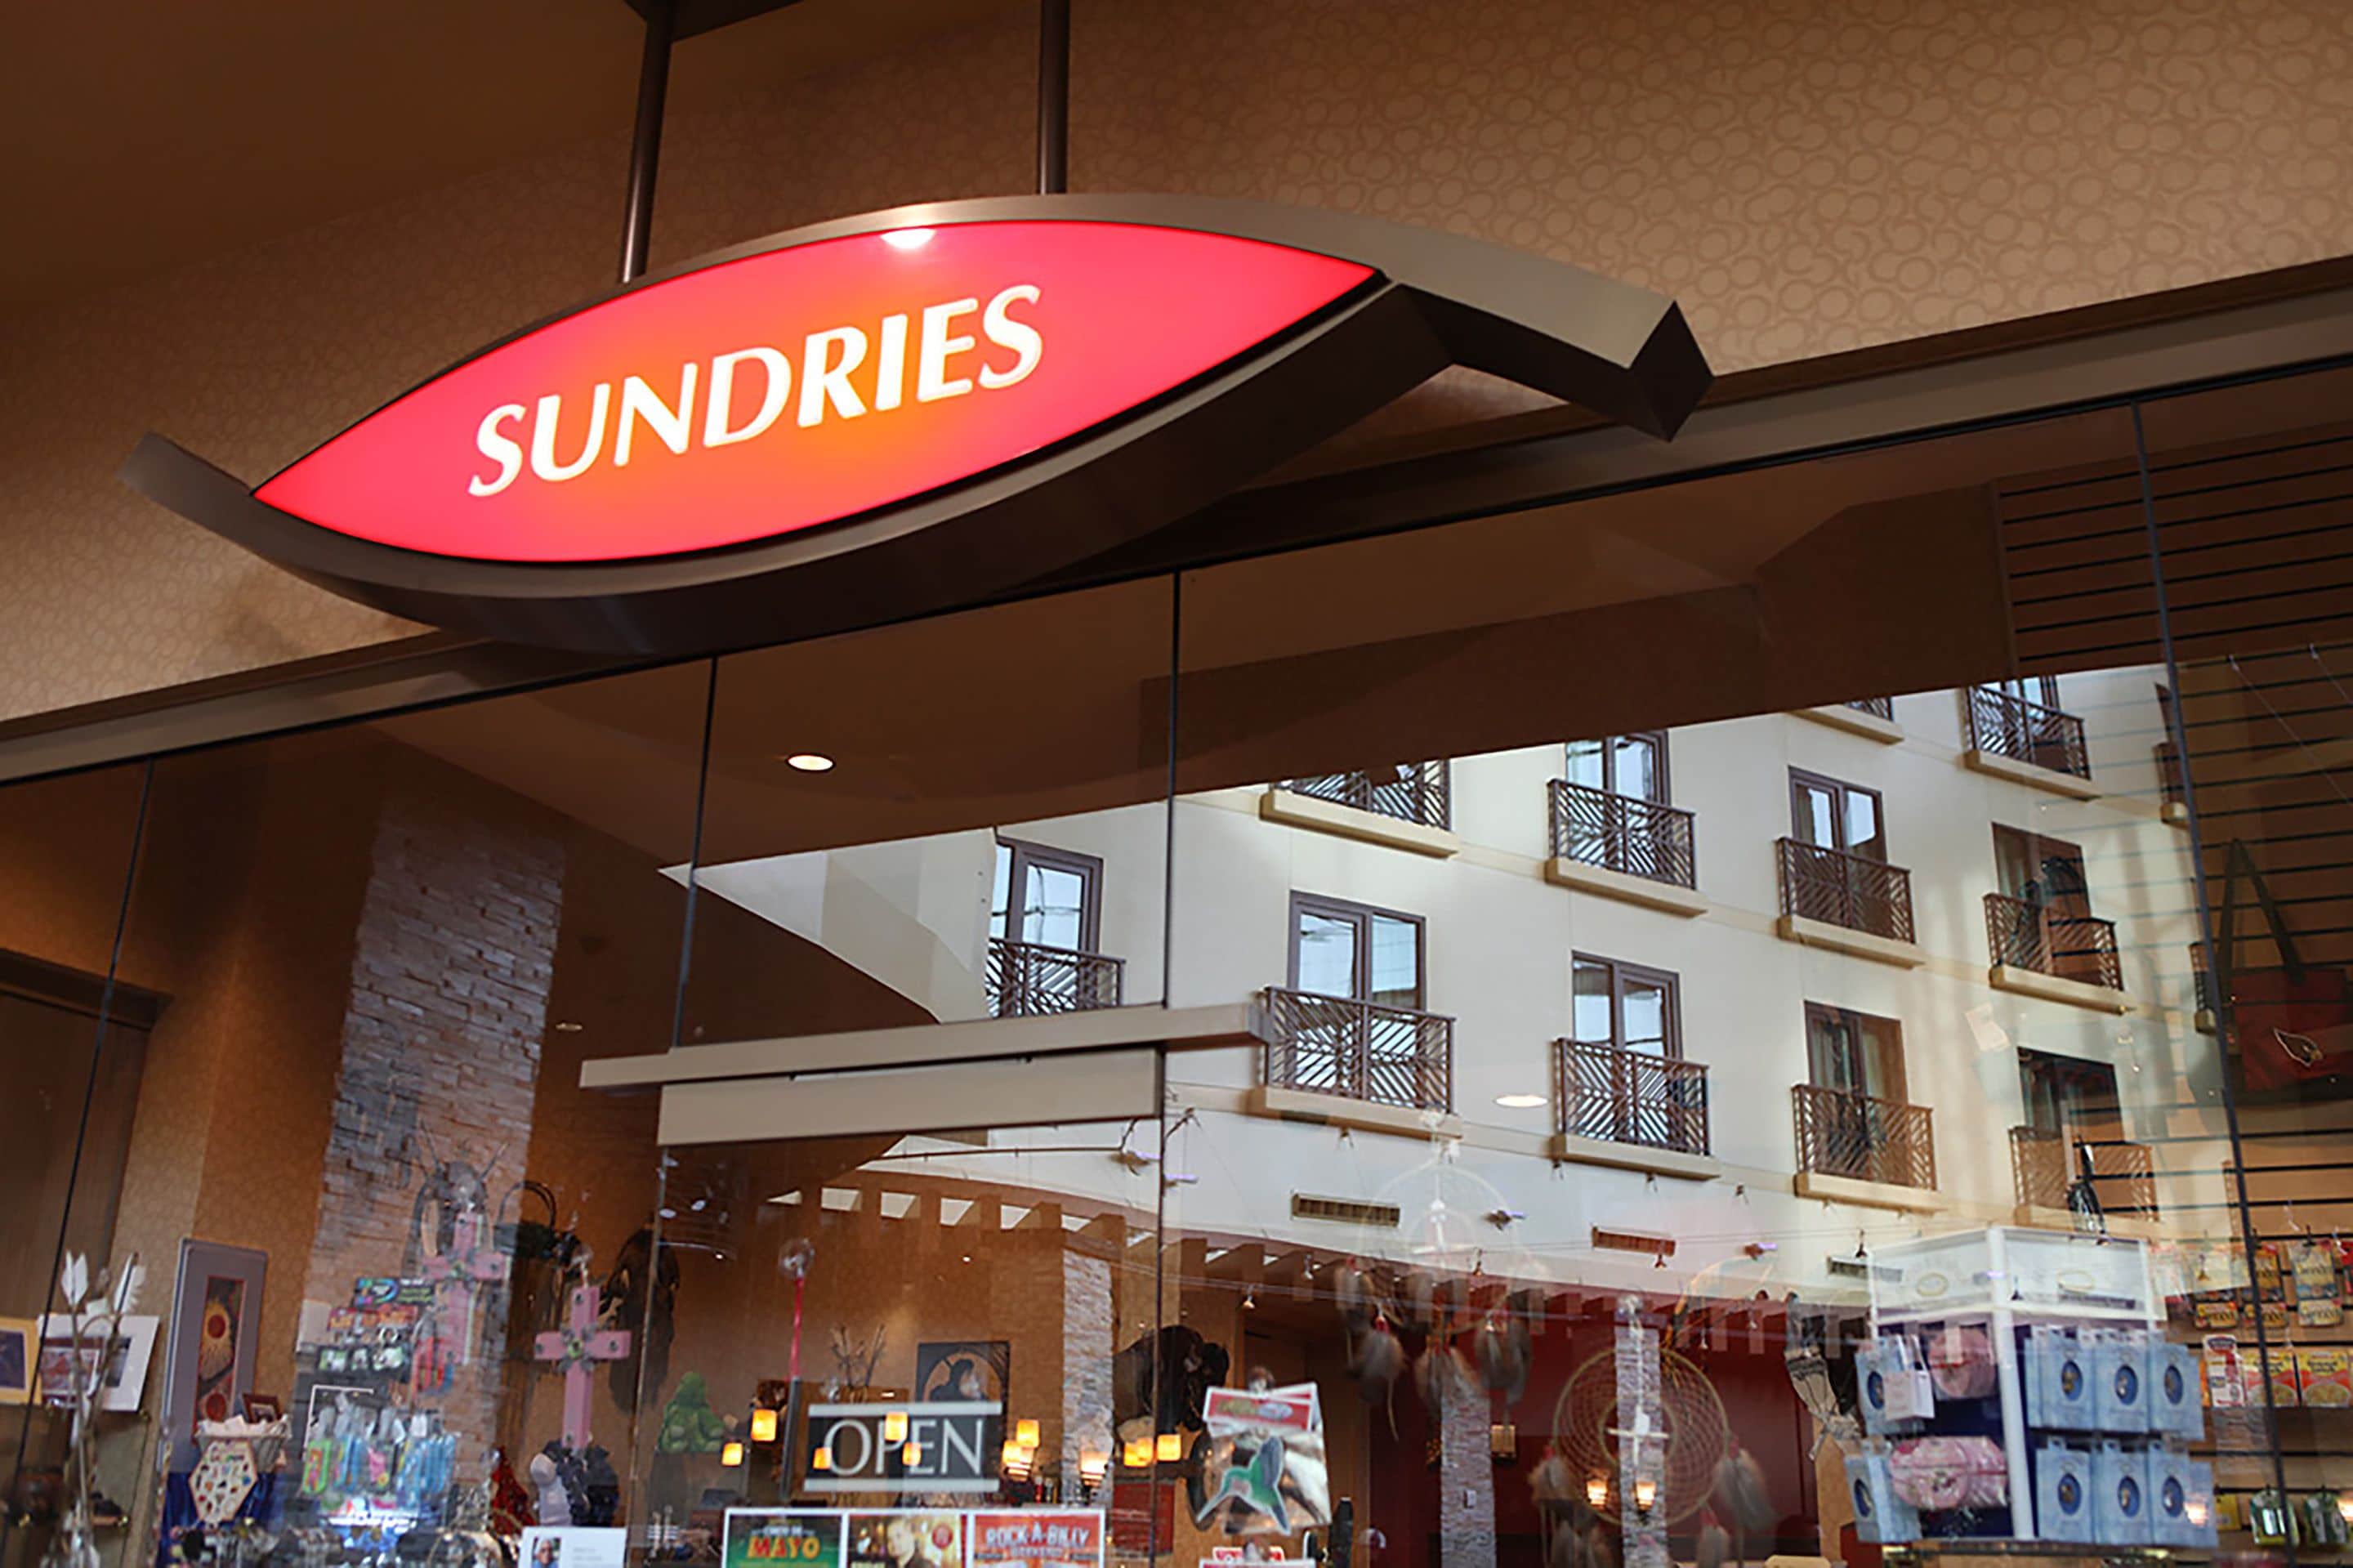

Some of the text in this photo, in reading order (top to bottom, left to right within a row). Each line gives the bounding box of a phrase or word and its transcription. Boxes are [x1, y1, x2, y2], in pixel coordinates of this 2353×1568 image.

[467, 284, 1044, 497] SUNDRIES
[823, 1418, 984, 1476] OPEN
[747, 1535, 821, 1559] MAYO
